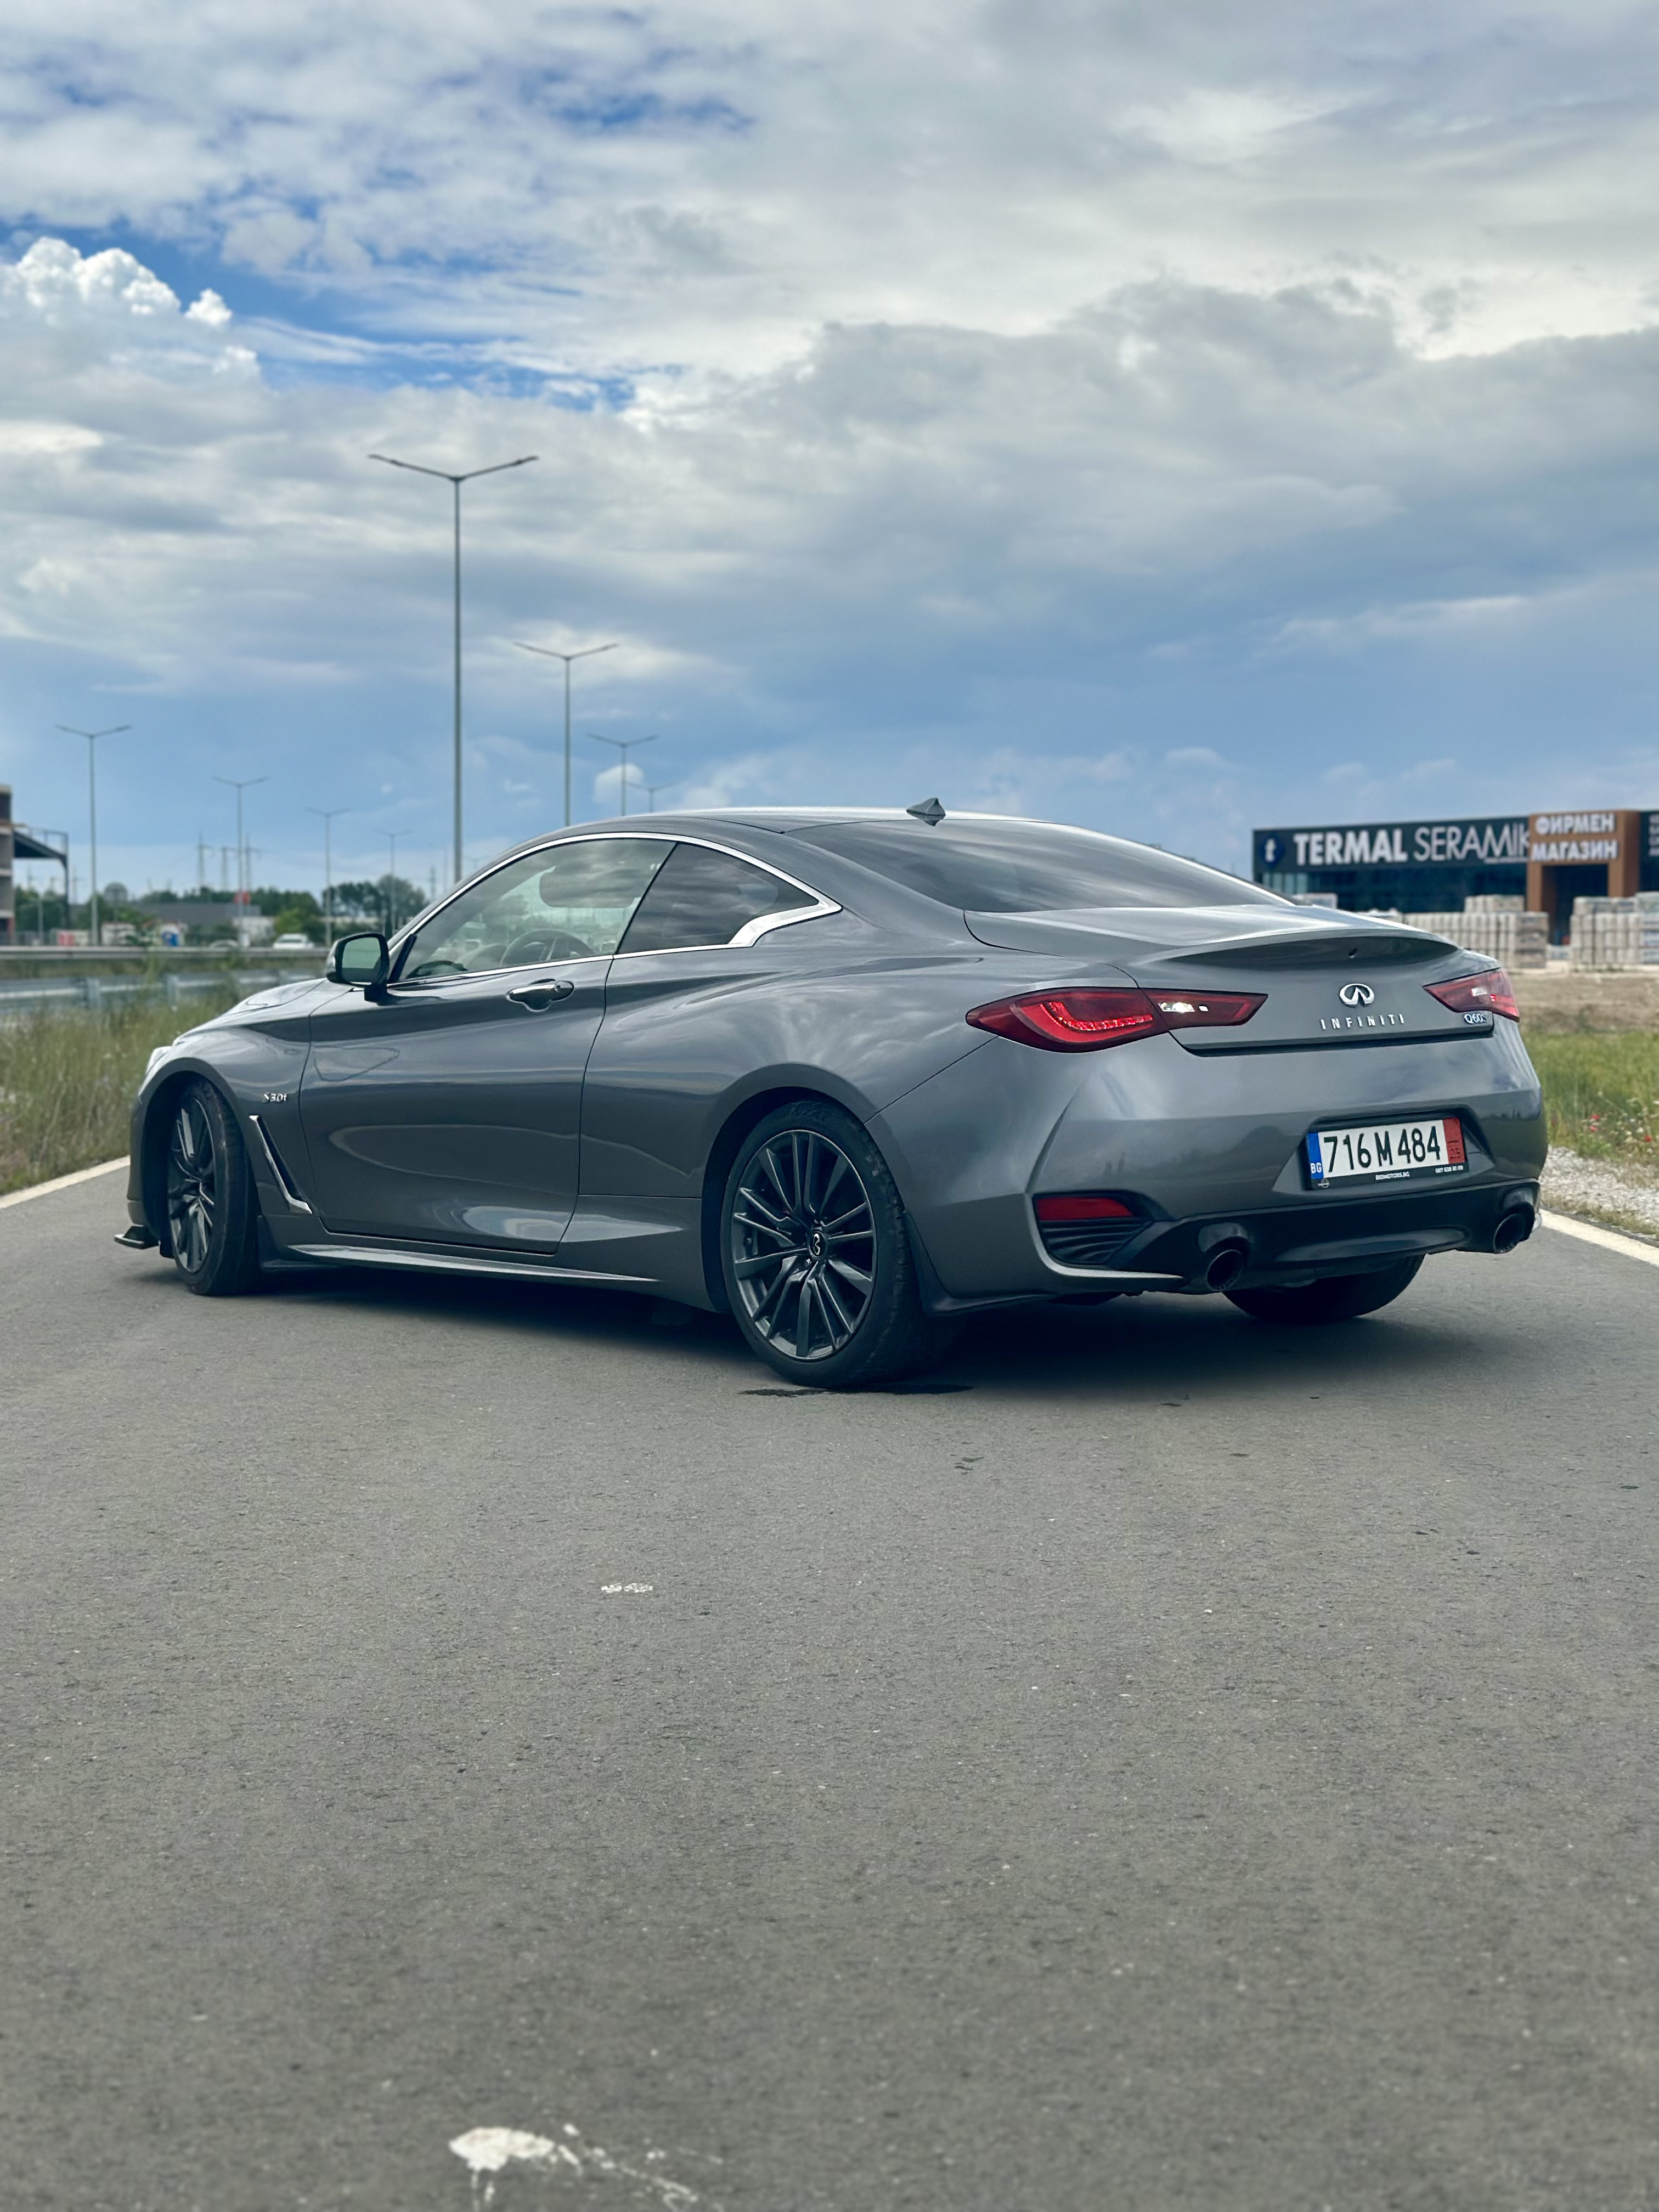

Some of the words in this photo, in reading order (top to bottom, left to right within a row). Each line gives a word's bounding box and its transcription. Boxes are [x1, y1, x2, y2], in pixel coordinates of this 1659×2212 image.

[1293, 829, 1408, 866] TERMAL
[1531, 839, 1618, 861] МАГАЗИН
[1320, 1013, 1404, 1030] INFINITI
[1310, 1162, 1323, 1174] BG
